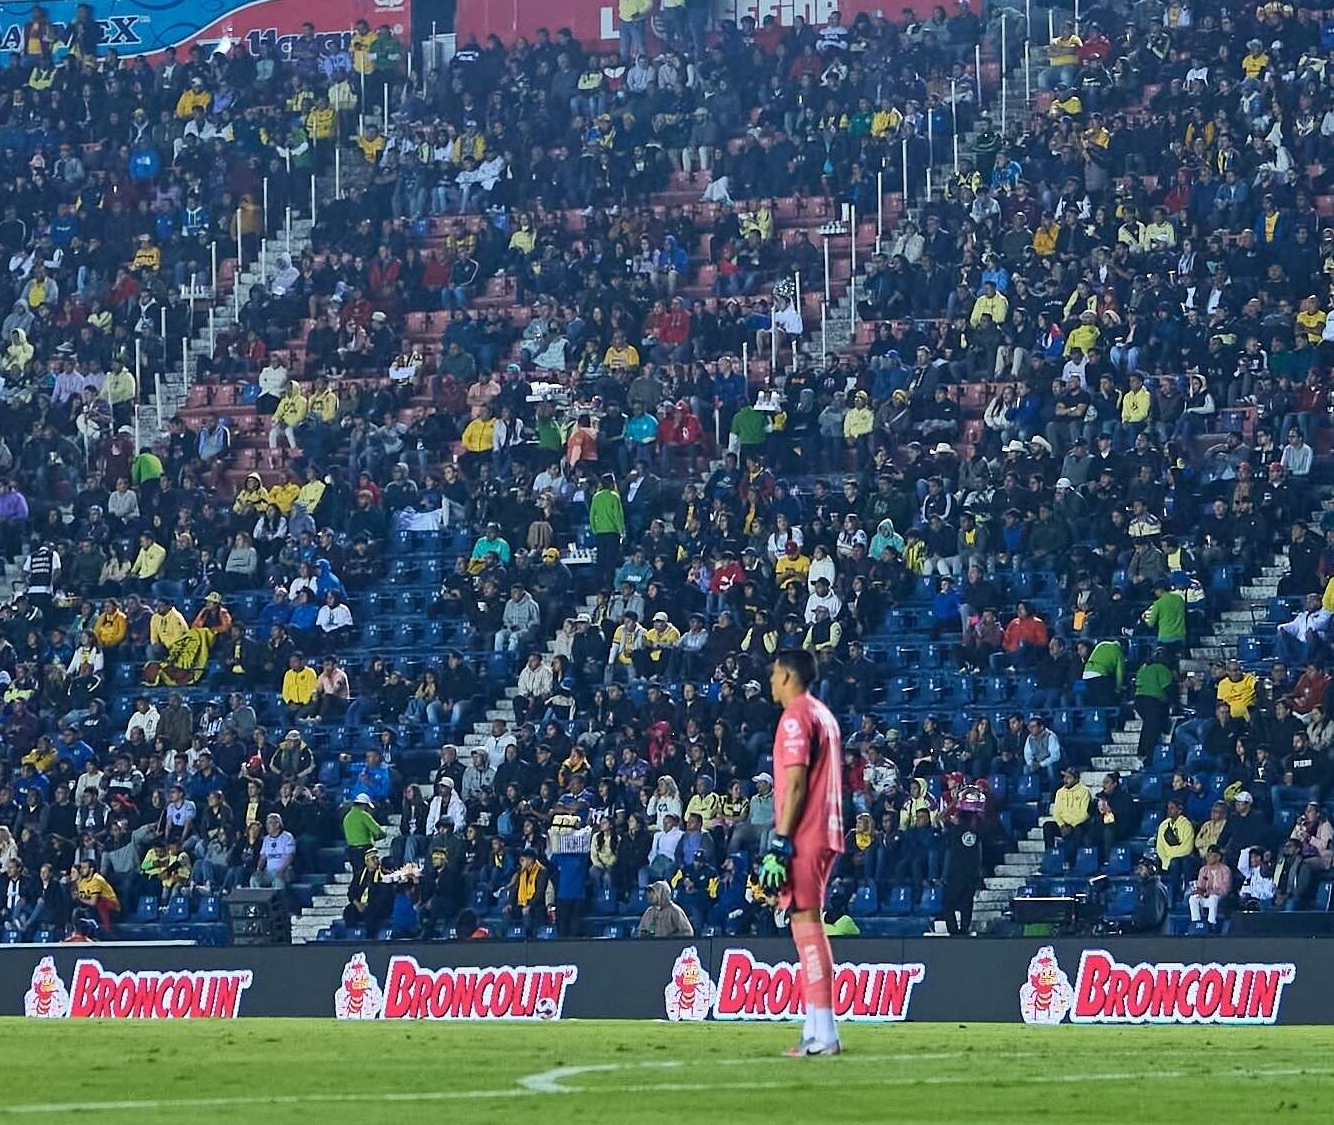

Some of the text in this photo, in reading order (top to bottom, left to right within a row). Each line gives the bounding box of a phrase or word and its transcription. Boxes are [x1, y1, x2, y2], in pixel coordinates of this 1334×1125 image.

[72, 961, 238, 1018] BRONCOLIN
[386, 961, 562, 1018] BRONCOLIN
[719, 954, 902, 1016] BRONOLIN
[1075, 955, 1280, 1017] BRONCOLIN
